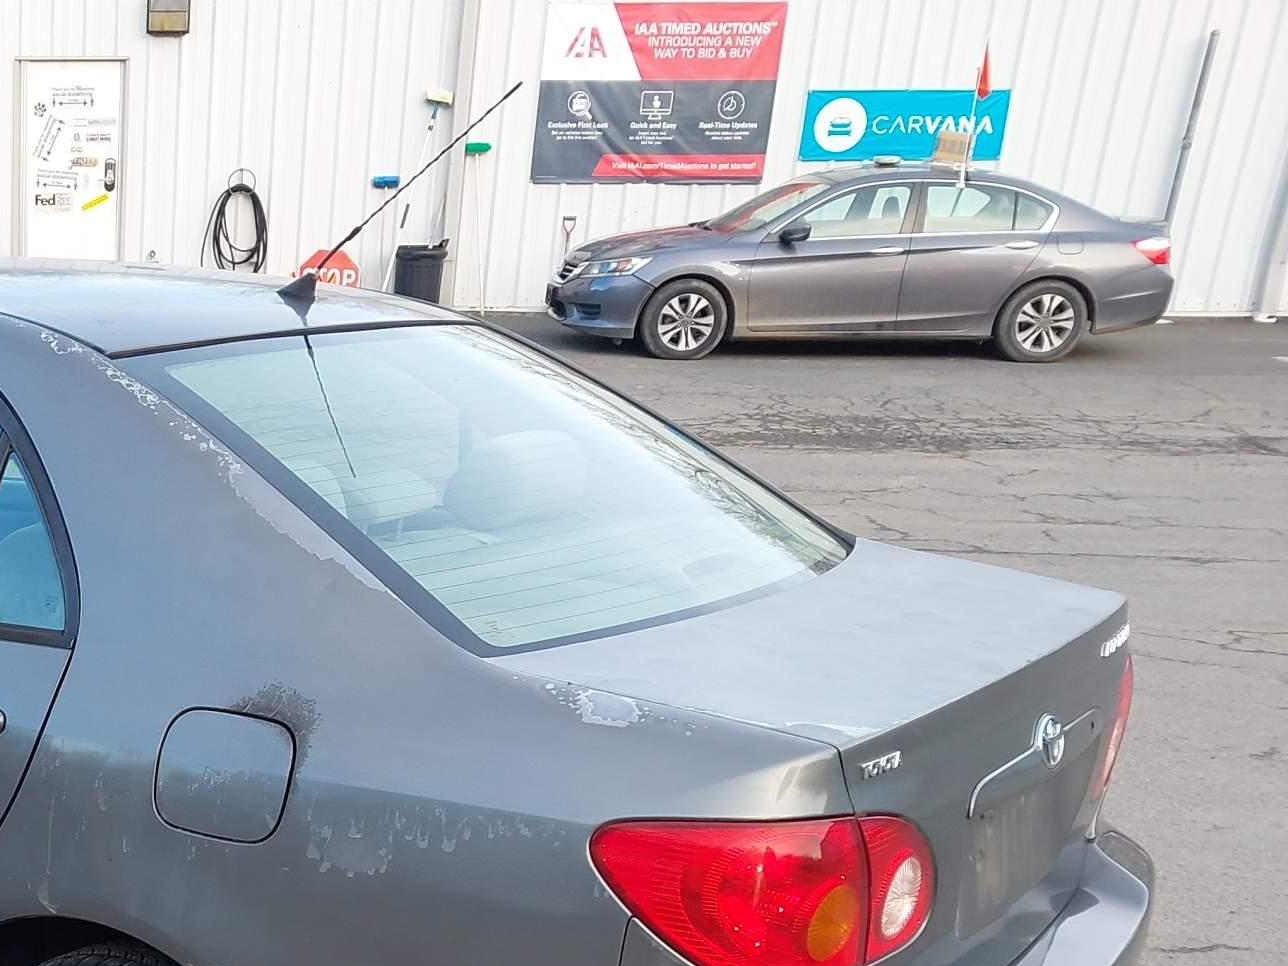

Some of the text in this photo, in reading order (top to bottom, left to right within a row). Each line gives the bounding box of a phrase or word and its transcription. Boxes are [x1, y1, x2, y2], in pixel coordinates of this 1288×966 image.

[635, 22, 658, 35] IAA
[660, 21, 701, 35] TIMED
[648, 35, 763, 47] INTRODUCING A NEW
[654, 48, 753, 59] WAY TO BID & BUY
[872, 114, 994, 135] CARVANA
